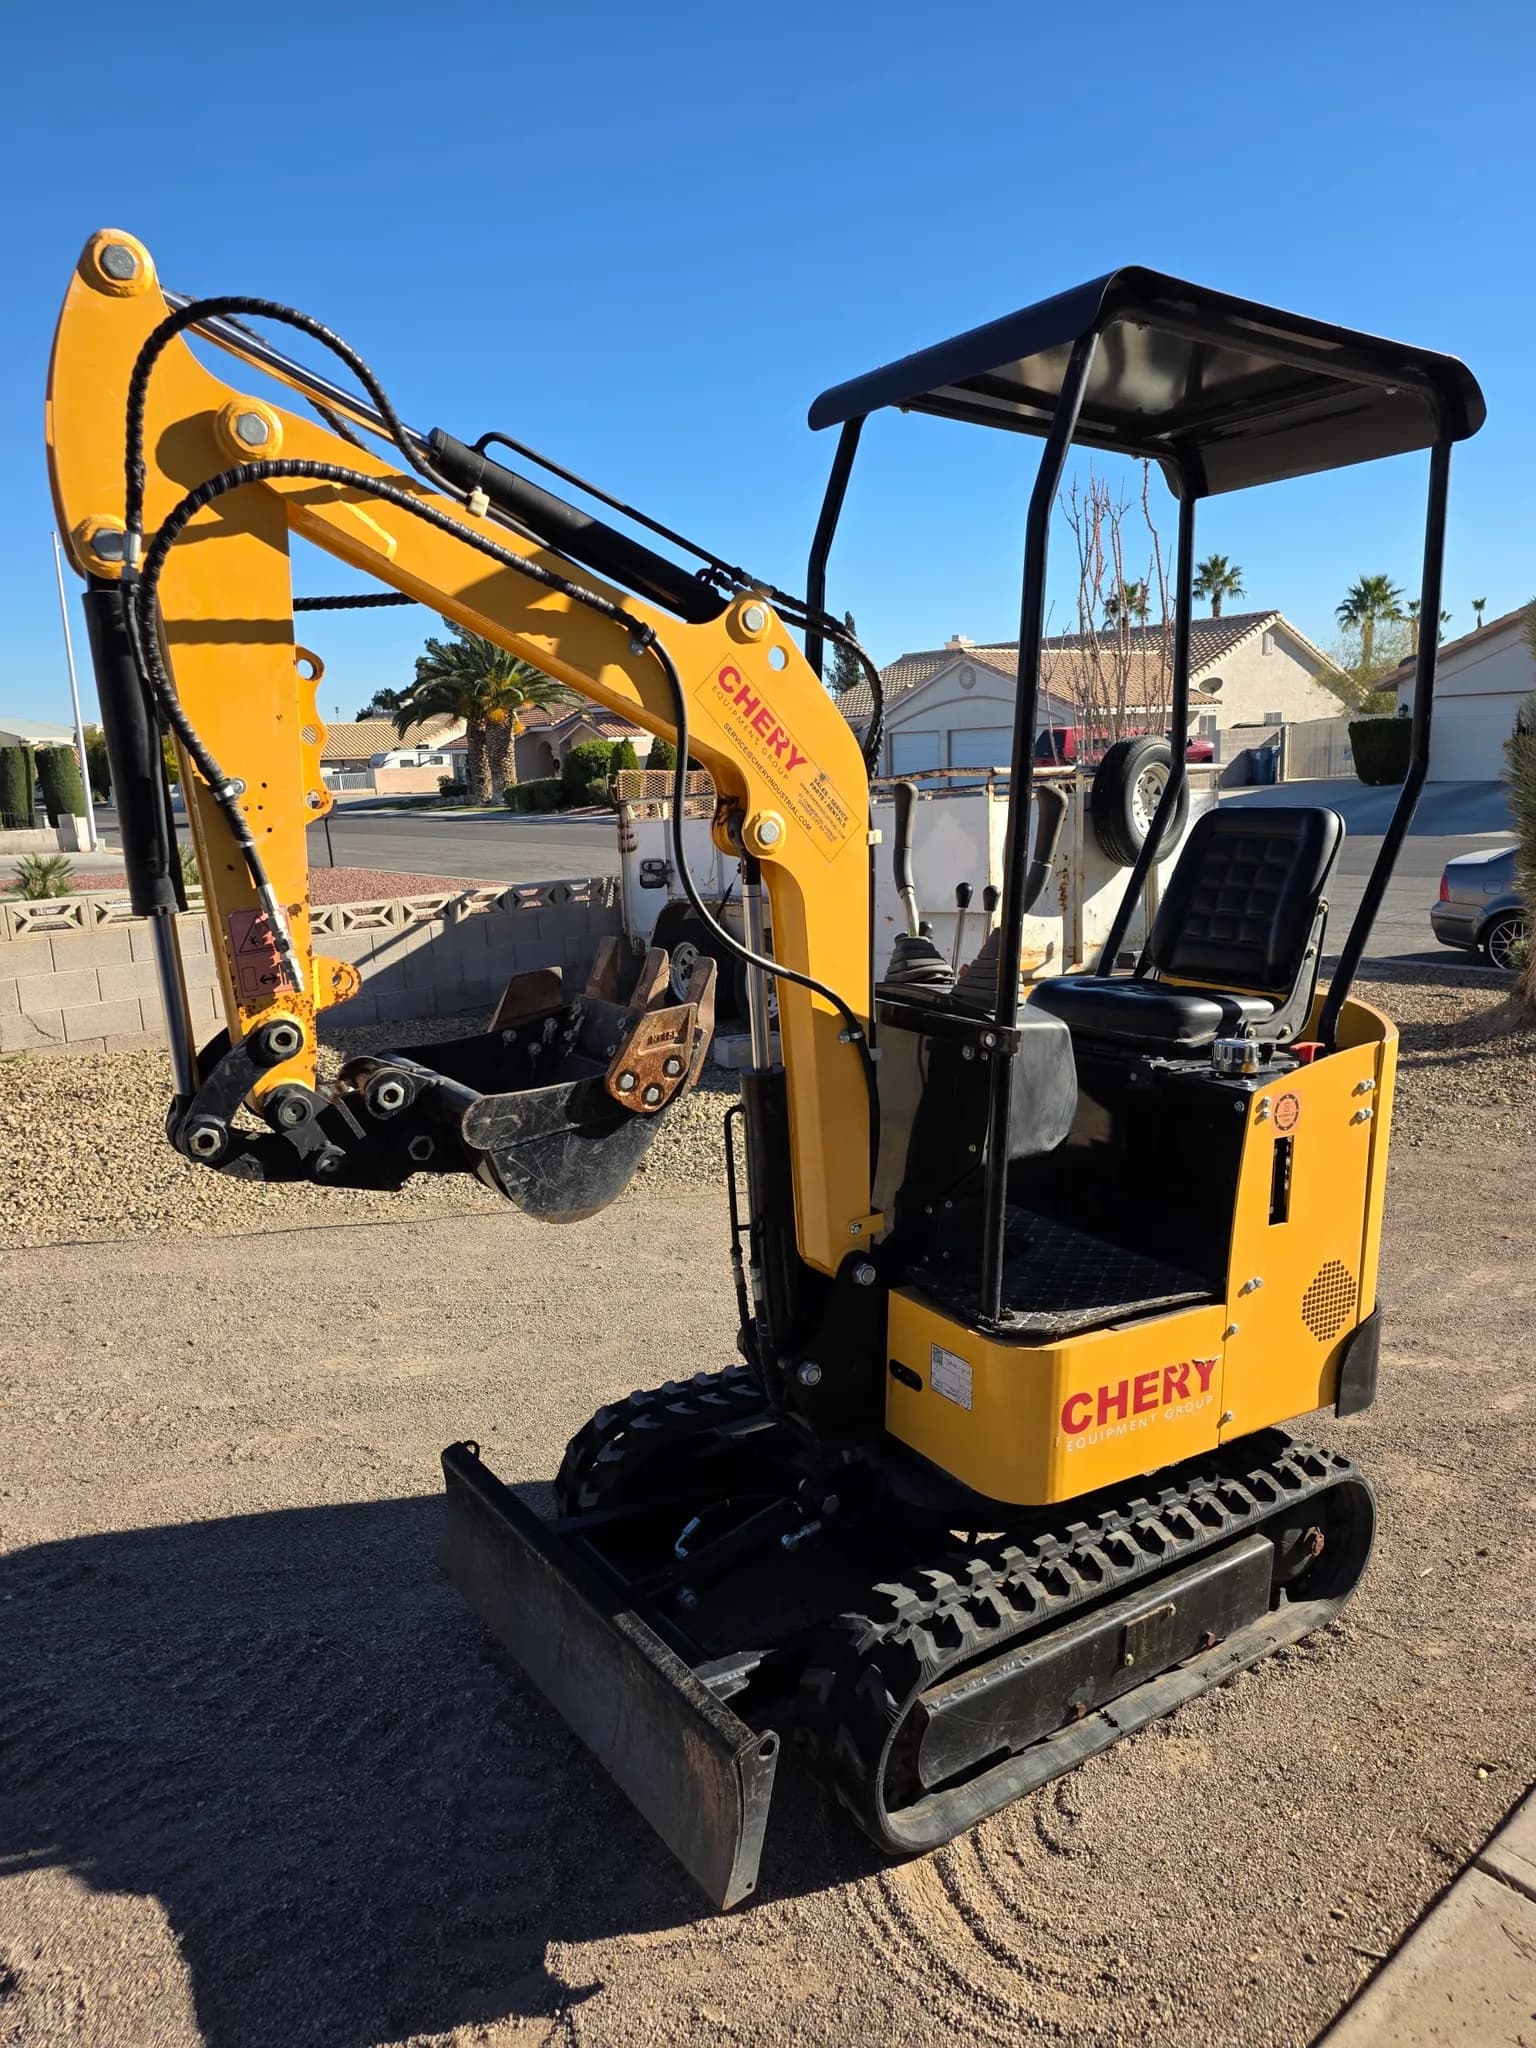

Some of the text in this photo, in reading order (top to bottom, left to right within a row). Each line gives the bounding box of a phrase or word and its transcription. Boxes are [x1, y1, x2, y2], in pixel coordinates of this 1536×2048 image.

[711, 684, 789, 781] EQUIPMENT GROUP
[718, 665, 807, 772] CHERY
[1061, 1359, 1217, 1435] CHERY
[1066, 1395, 1213, 1452] EQUIPMENT GROUP
